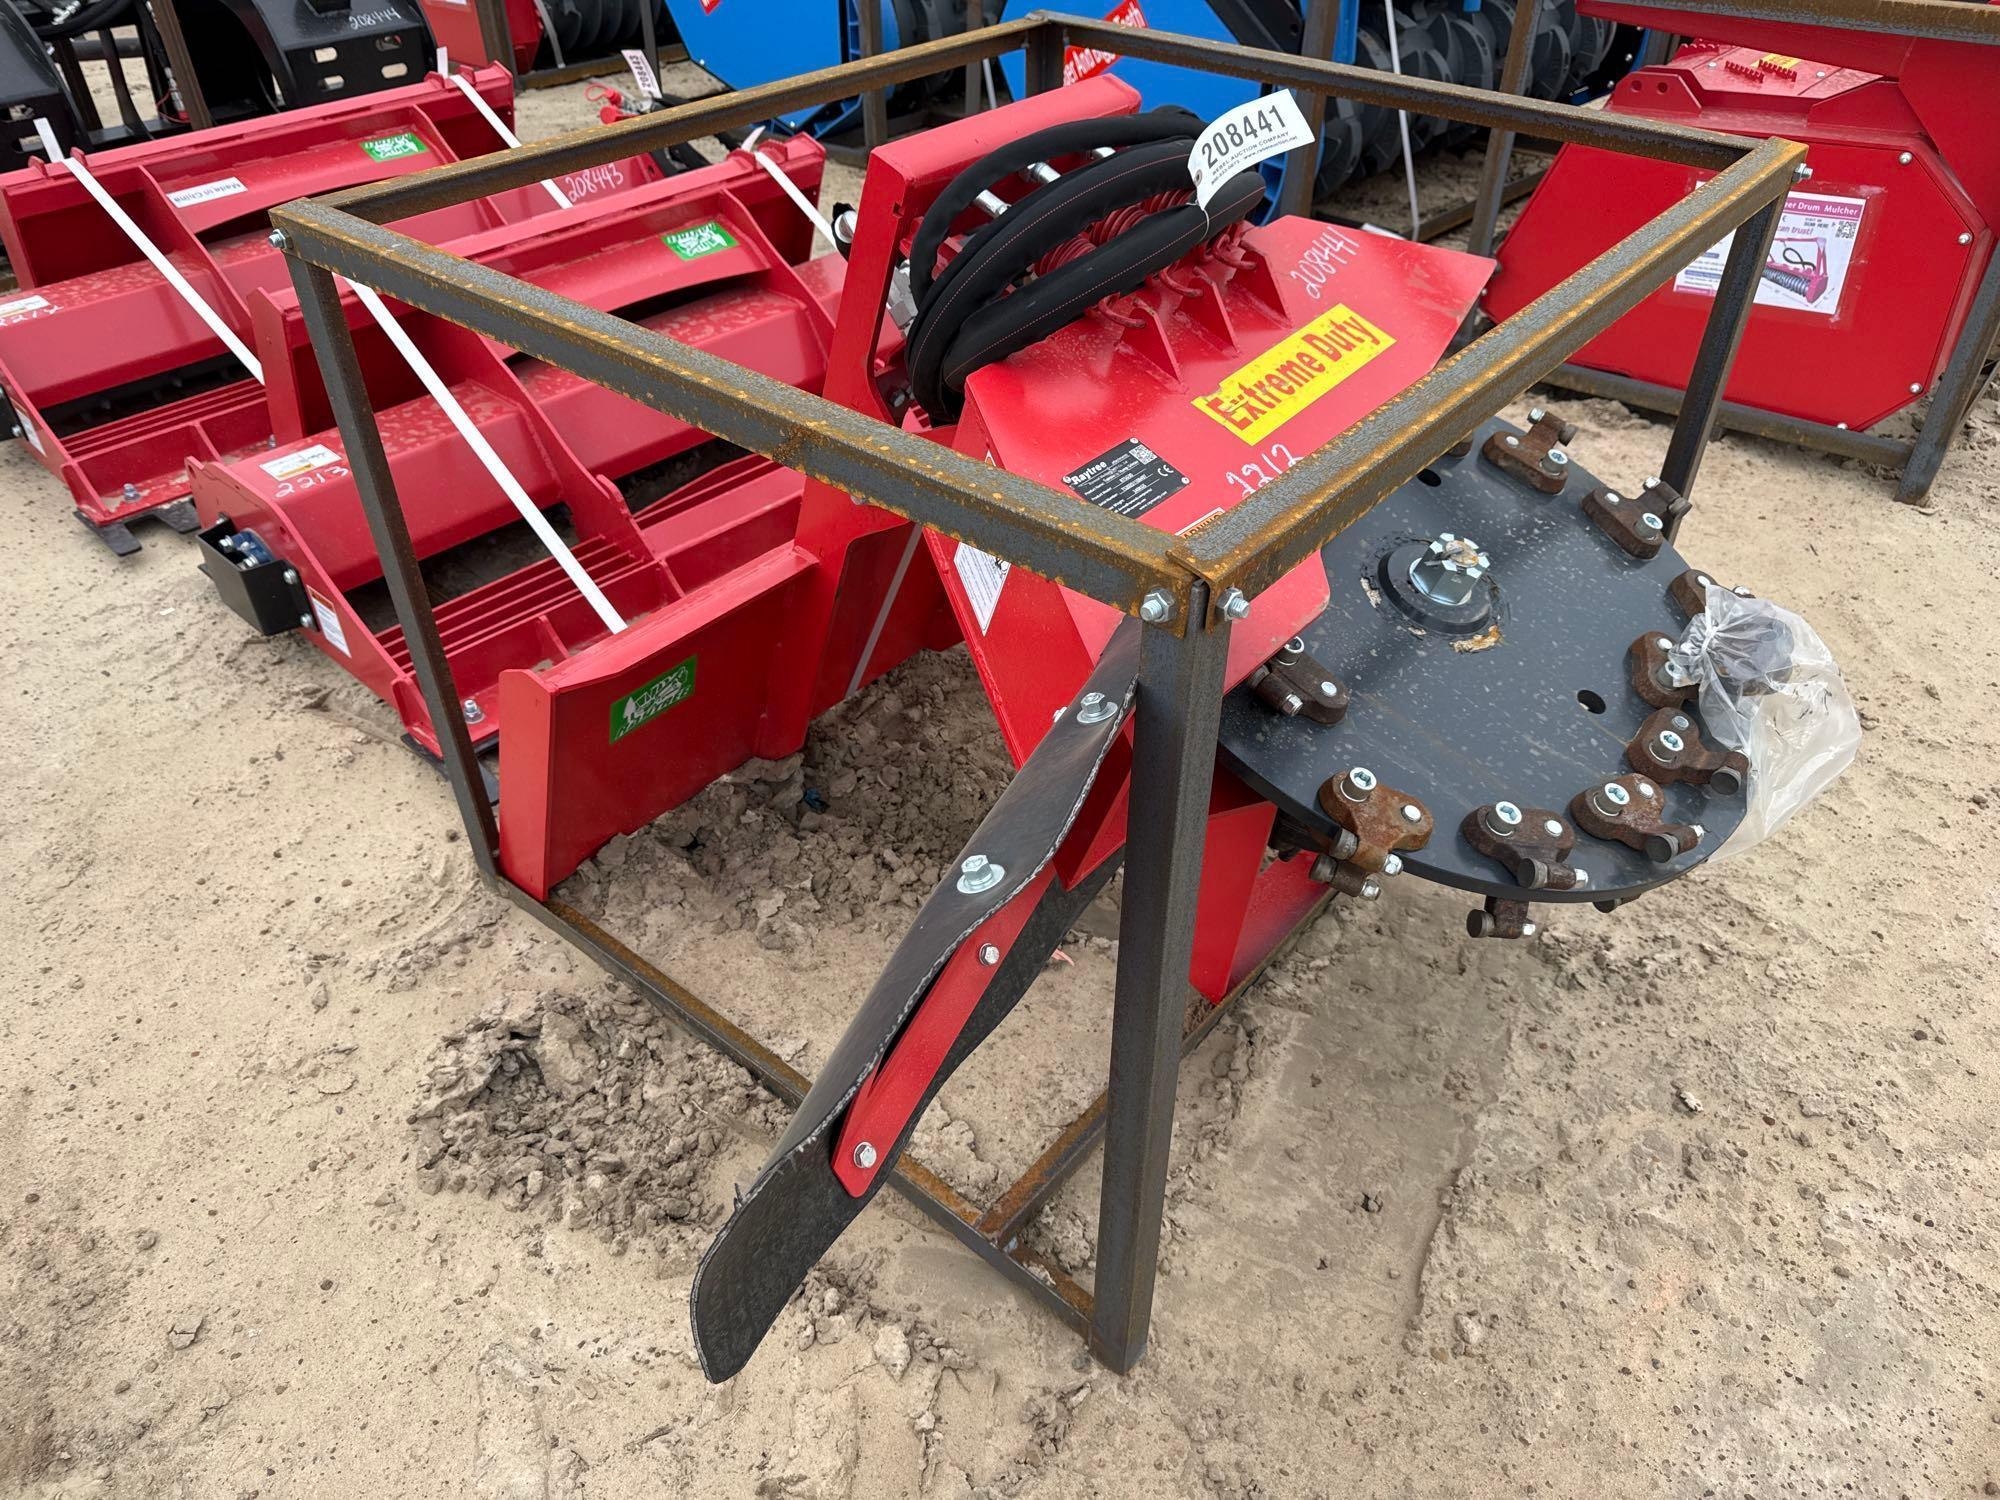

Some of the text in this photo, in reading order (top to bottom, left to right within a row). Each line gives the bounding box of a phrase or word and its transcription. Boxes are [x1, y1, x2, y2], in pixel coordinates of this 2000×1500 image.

[348, 7, 402, 30] 208444
[1201, 105, 1286, 169] 208441
[1230, 143, 1258, 160] AUCTION
[1259, 131, 1290, 147] COMPANY
[565, 162, 624, 203] 208443
[1797, 201, 1821, 212] Drum
[1823, 205, 1859, 216] Mulcher
[1791, 227, 1814, 235] trust!
[1290, 226, 1360, 299] 208441
[1204, 315, 1381, 431] Extreme Duty
[275, 465, 349, 498] 2213
[1070, 461, 1108, 485] Raytree
